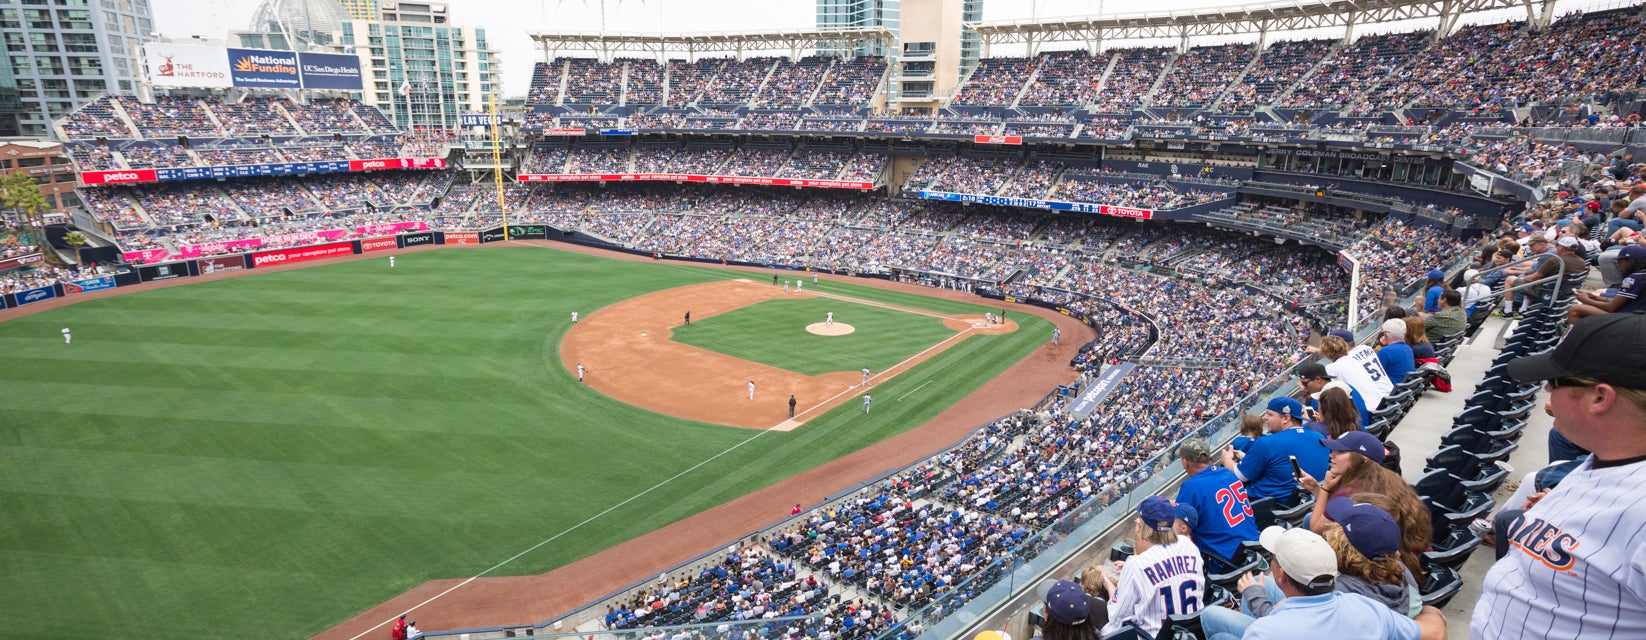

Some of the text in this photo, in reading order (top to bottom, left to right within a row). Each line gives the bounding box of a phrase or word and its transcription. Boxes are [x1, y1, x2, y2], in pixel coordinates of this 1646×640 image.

[250, 55, 295, 65] National
[252, 64, 296, 74] Funding
[464, 116, 477, 125] LAS
[1296, 150, 1337, 158] COLEMAN
[1339, 152, 1390, 162] BROADCAST
[103, 172, 139, 182] petco
[255, 254, 286, 265] petco
[302, 249, 327, 257] complete
[1363, 357, 1385, 381] 51
[1215, 480, 1253, 528] 25
[1144, 556, 1197, 585] RAMIREZ
[1160, 580, 1198, 620] 16
